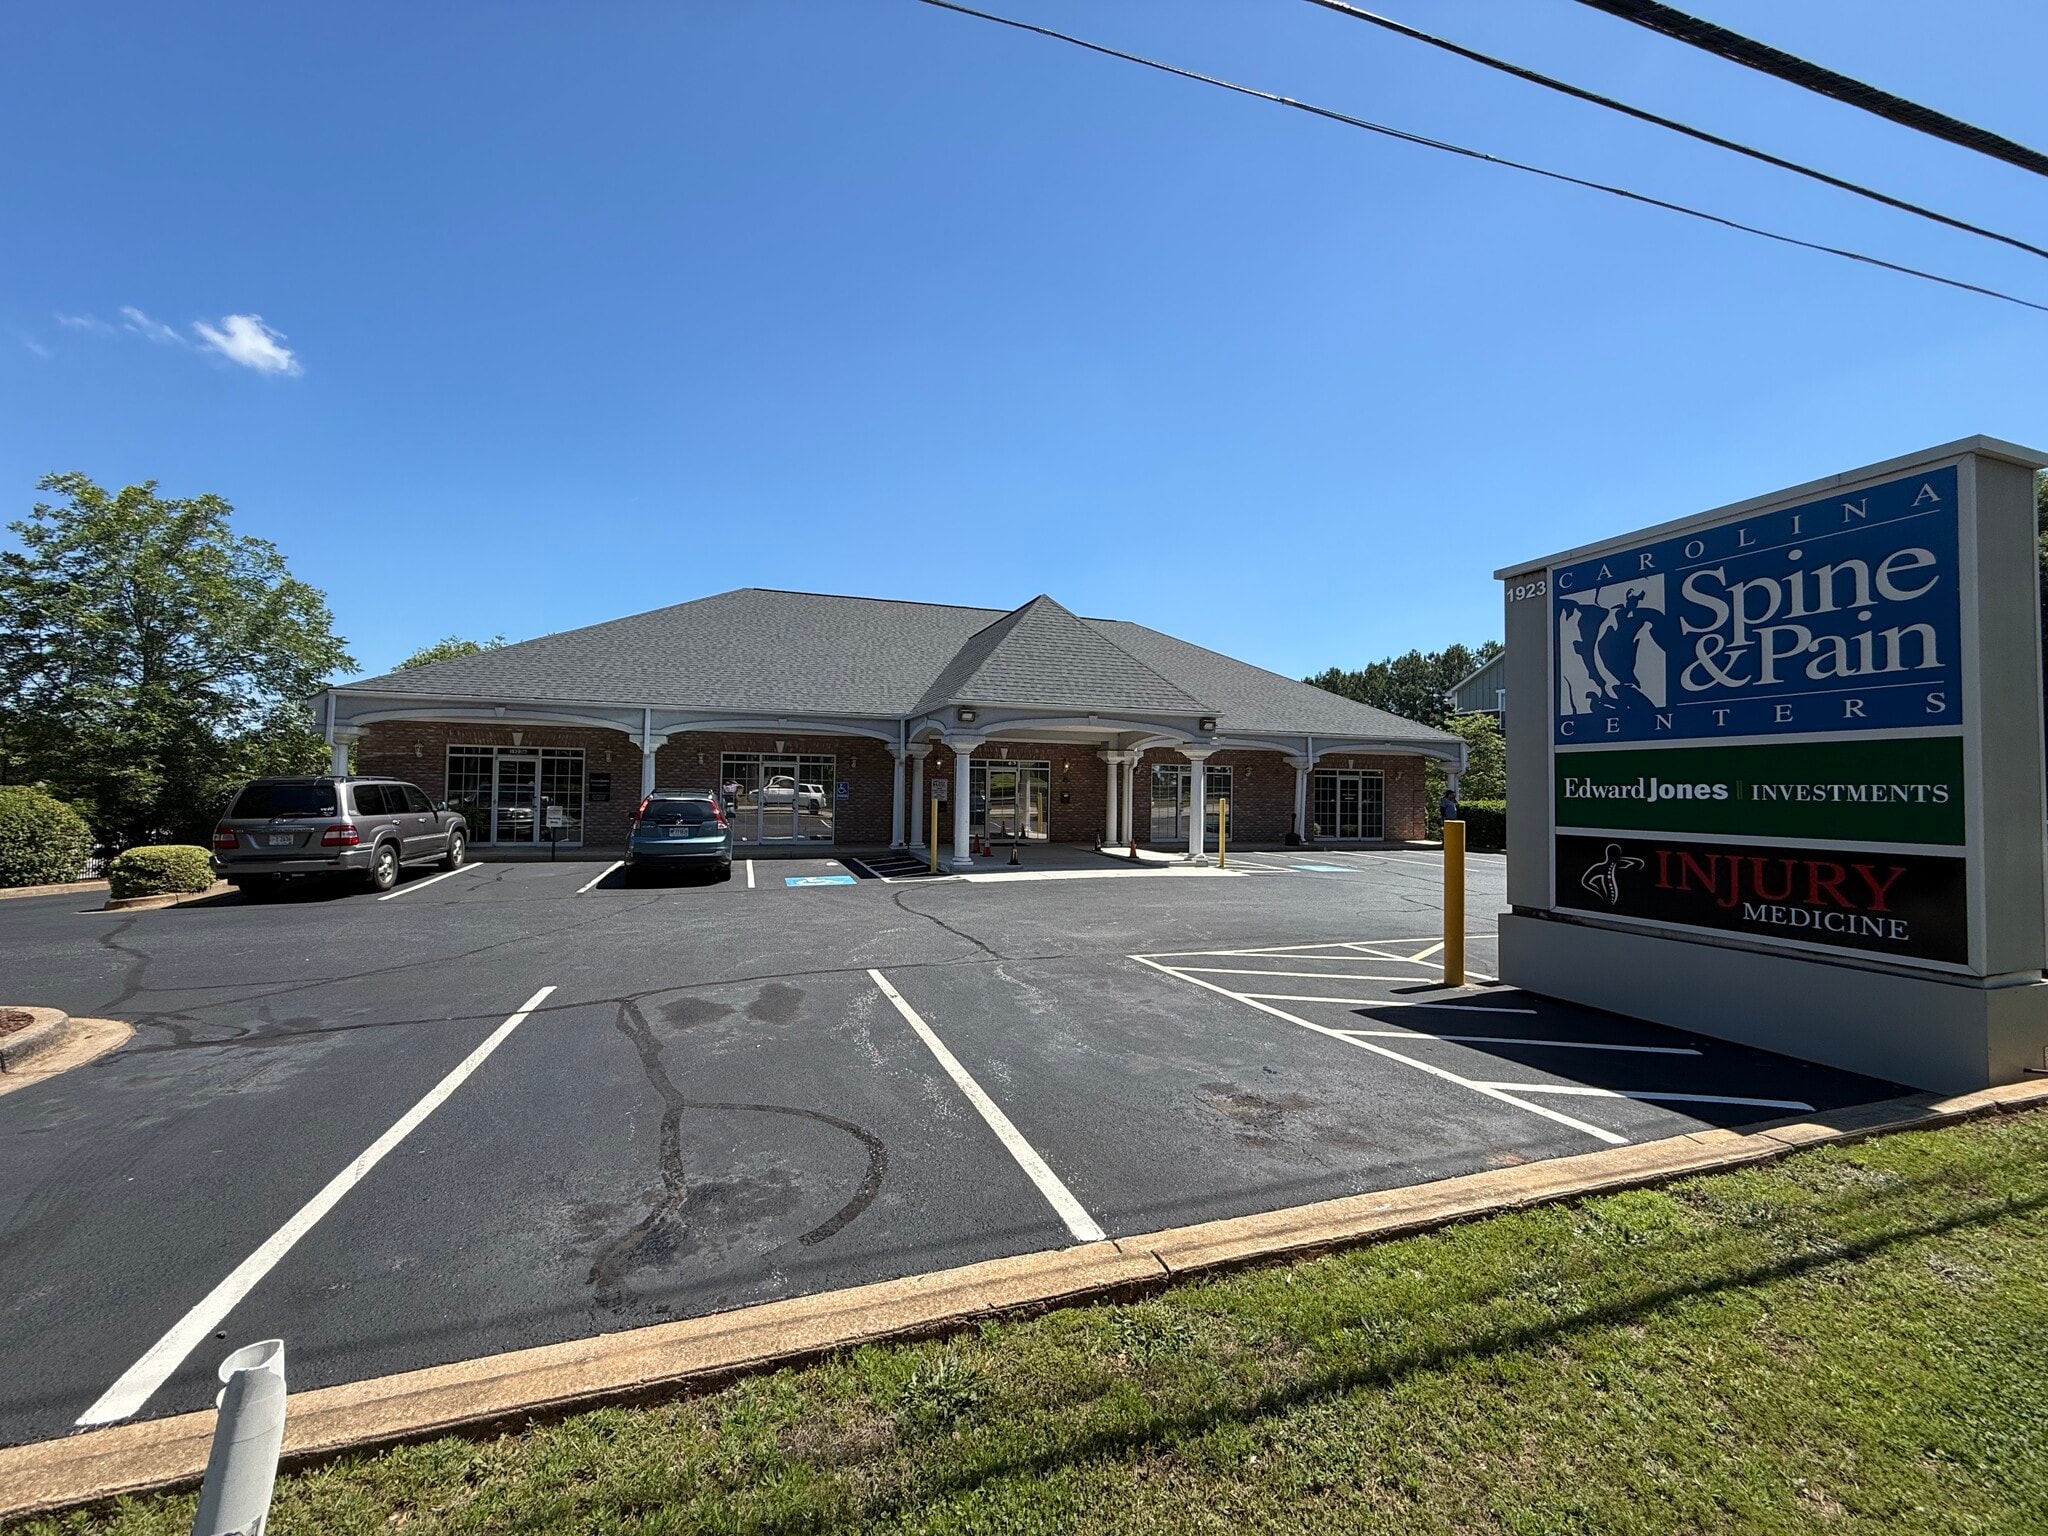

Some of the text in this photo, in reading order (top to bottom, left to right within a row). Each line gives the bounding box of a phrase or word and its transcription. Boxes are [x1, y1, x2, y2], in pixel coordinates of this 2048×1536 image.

[1558, 483, 1942, 589] CAROLINA
[1507, 580, 1547, 602] 1923
[1680, 547, 1940, 648] Spine
[1560, 692, 1947, 736] CENTERS
[1751, 783, 1950, 804] INVESTMENTS
[1655, 849, 1908, 912] INJURY
[1743, 902, 1910, 941] MEDICINE
